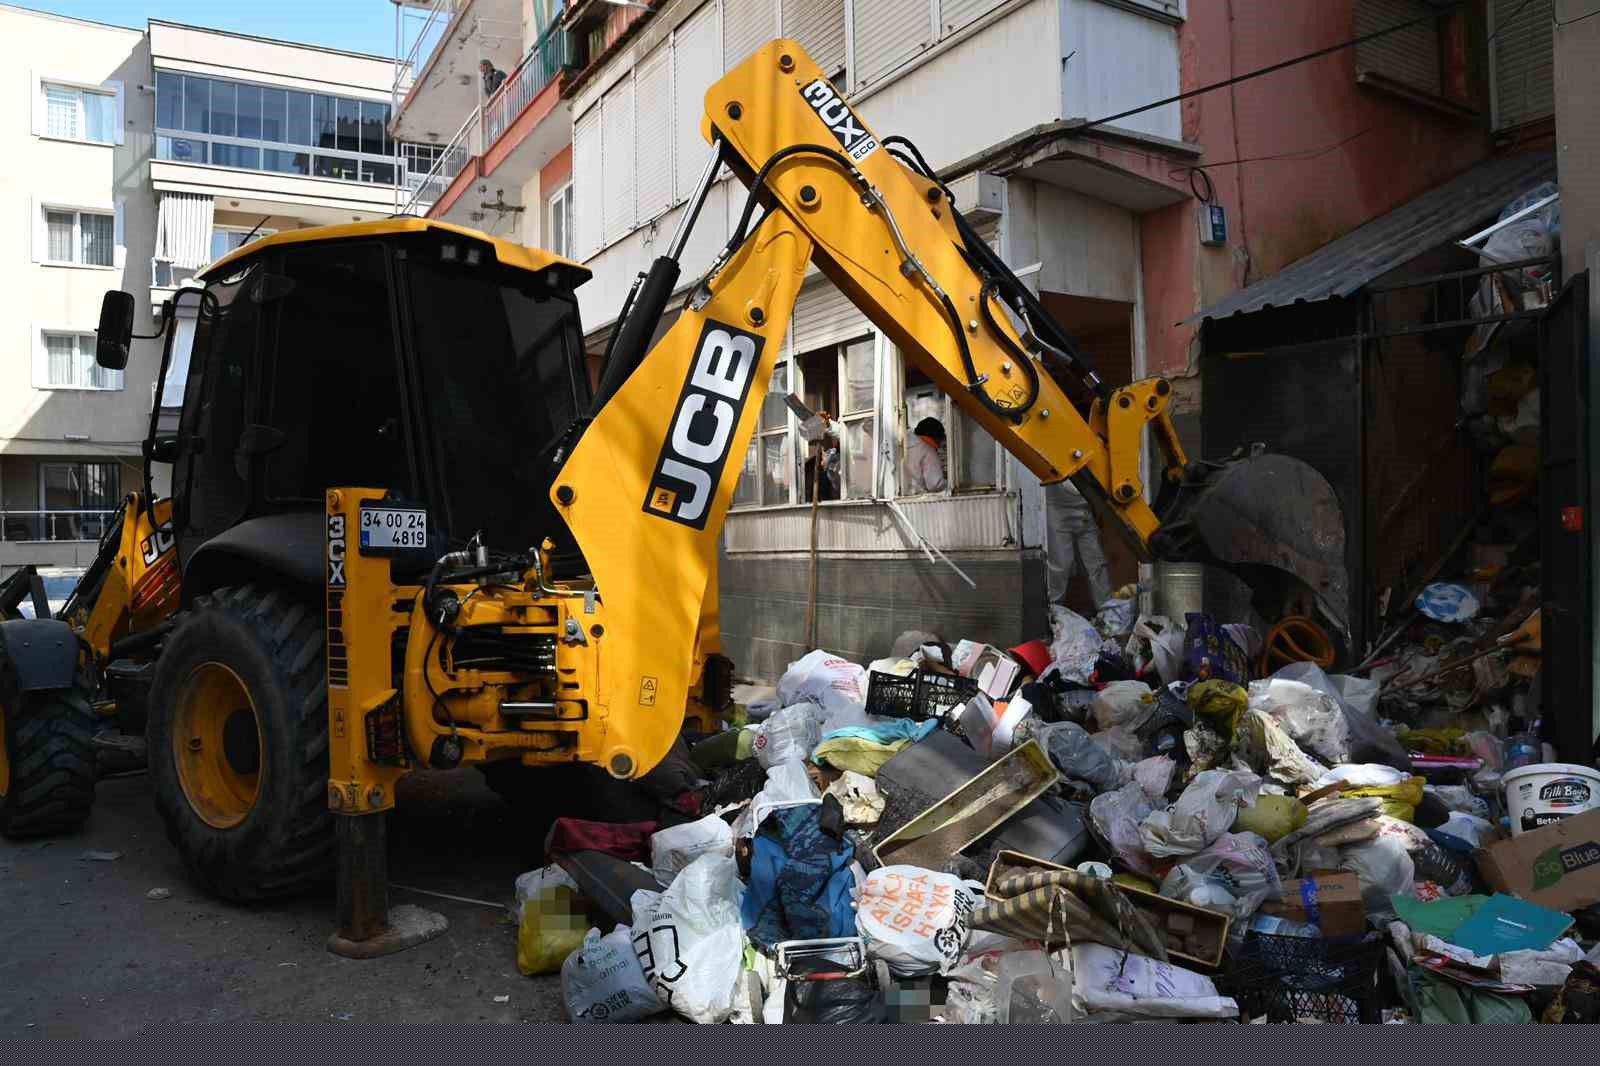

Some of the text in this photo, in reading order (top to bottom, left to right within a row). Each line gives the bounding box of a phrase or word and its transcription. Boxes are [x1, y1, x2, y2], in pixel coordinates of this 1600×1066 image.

[804, 80, 866, 147] 3CX
[853, 140, 876, 160] ECO
[660, 329, 756, 521] JCB
[363, 511, 424, 529] 34 00 24
[392, 531, 425, 545] 4819
[144, 521, 175, 565] JC
[328, 516, 345, 584] 3CX
